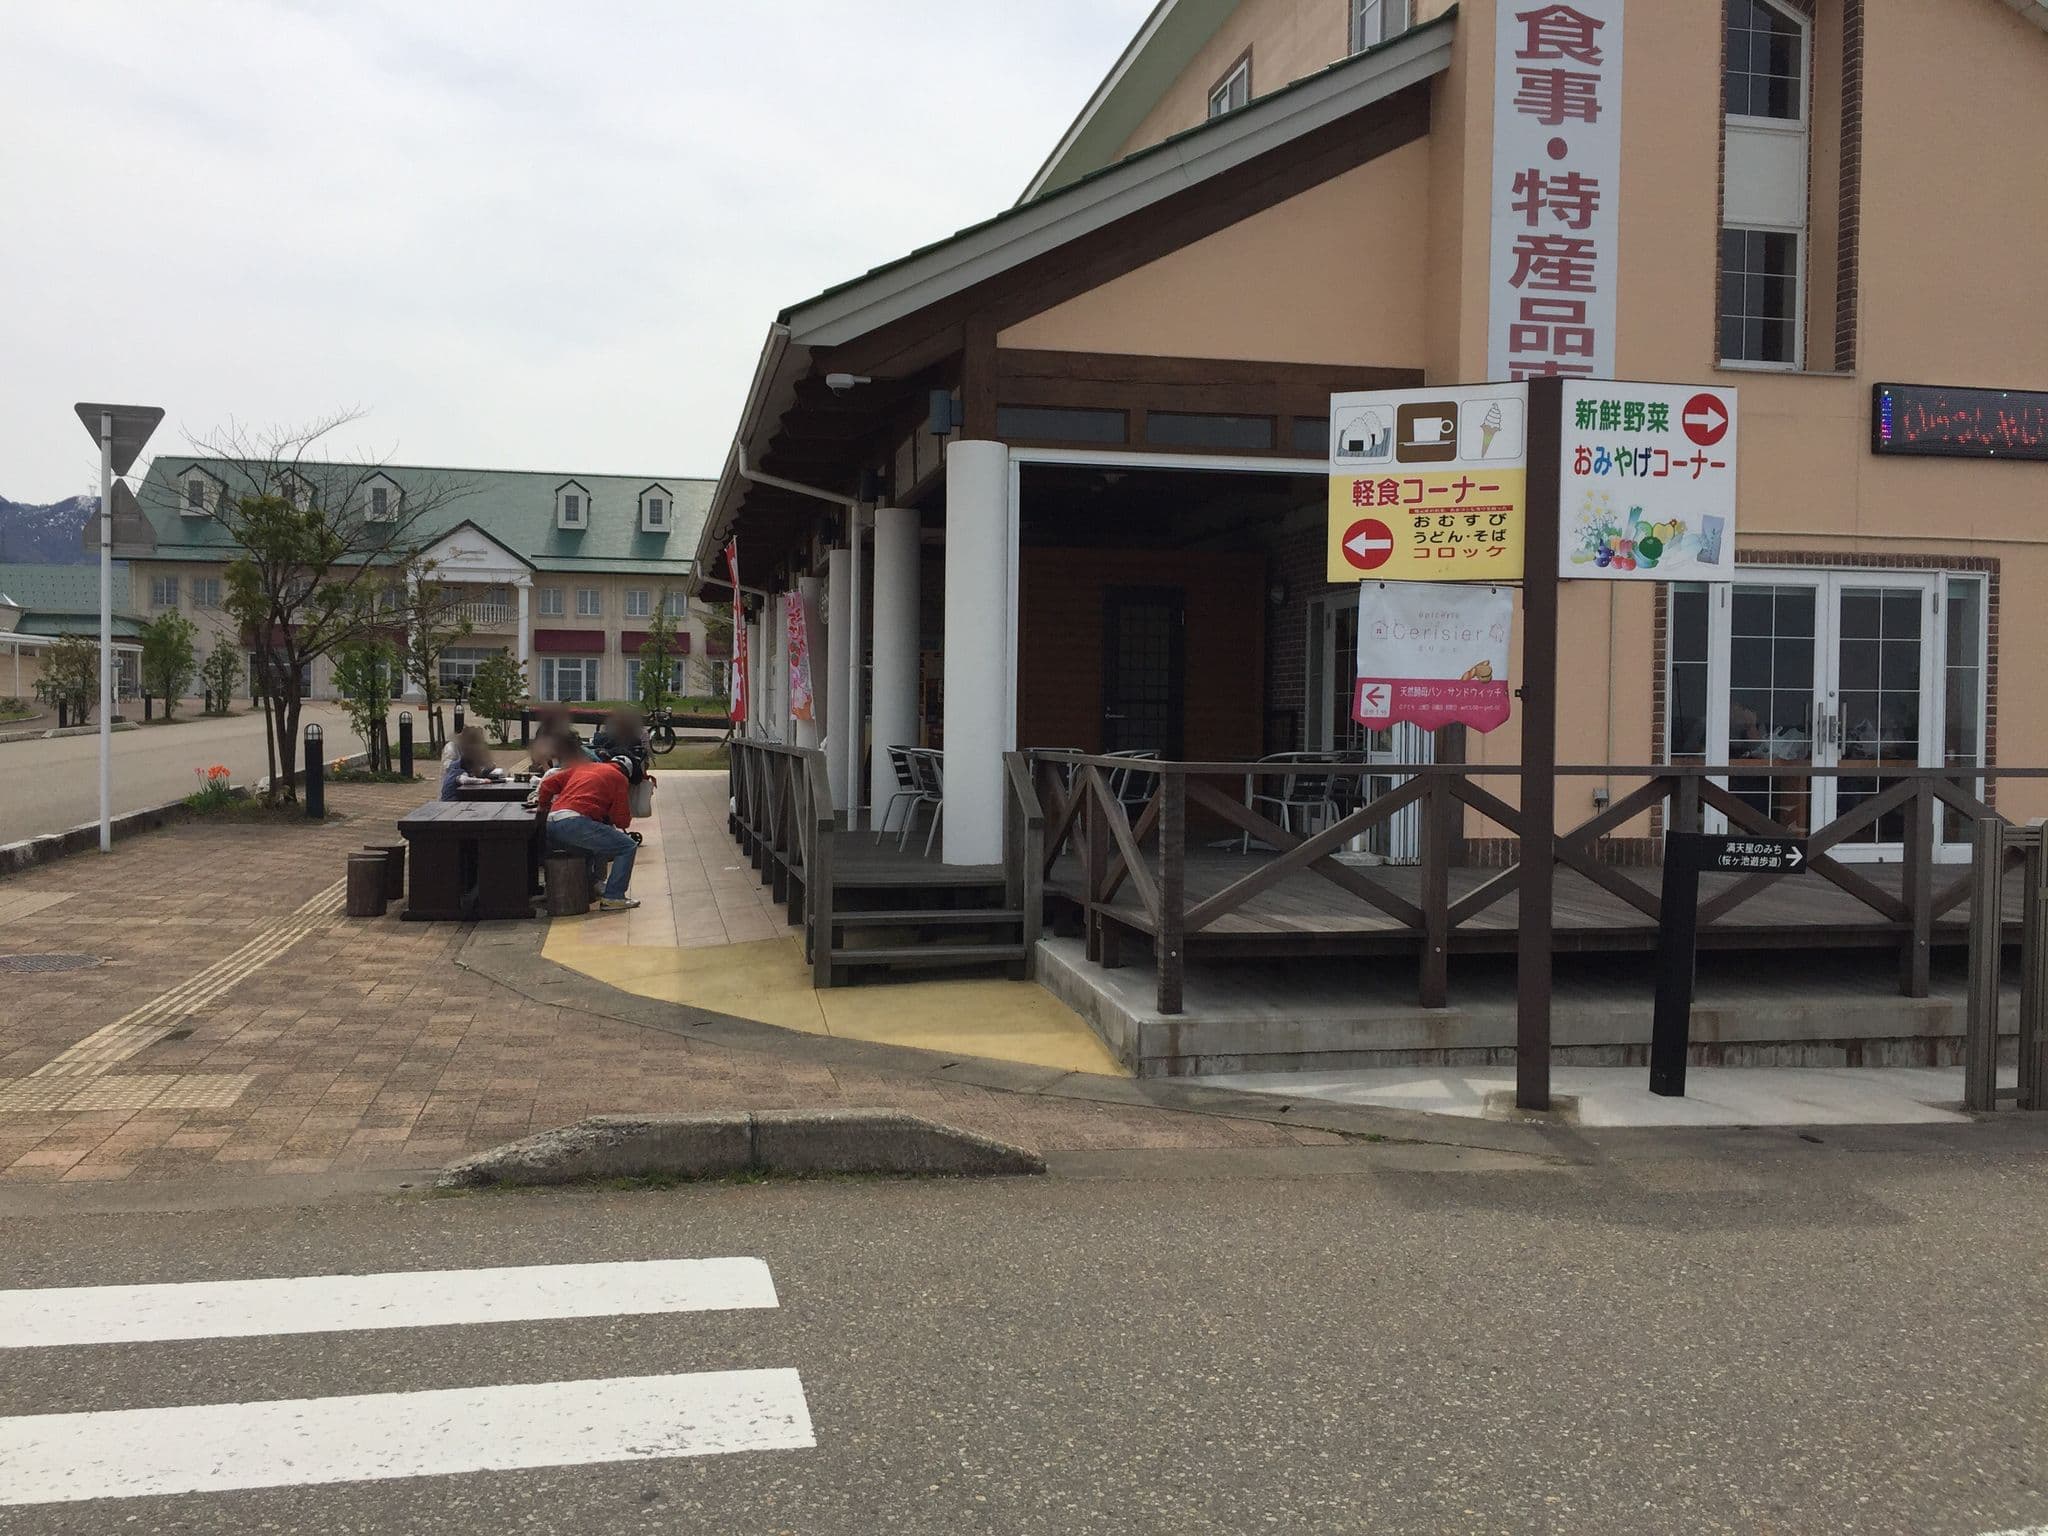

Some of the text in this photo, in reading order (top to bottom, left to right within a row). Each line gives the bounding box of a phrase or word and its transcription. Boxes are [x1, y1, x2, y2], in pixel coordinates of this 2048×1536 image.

[1575, 398, 1670, 433] 新鮮野菜
[1573, 443, 1726, 480] おみやげコーナー
[1352, 475, 1500, 507] 軽食コーナー
[1413, 513, 1507, 528] おむすび
[1413, 529, 1507, 544] うどん・そば
[1413, 545, 1507, 559] コロッケ
[1393, 623, 1484, 641] Cerisier
[1726, 842, 1783, 854] 満天星のみち
